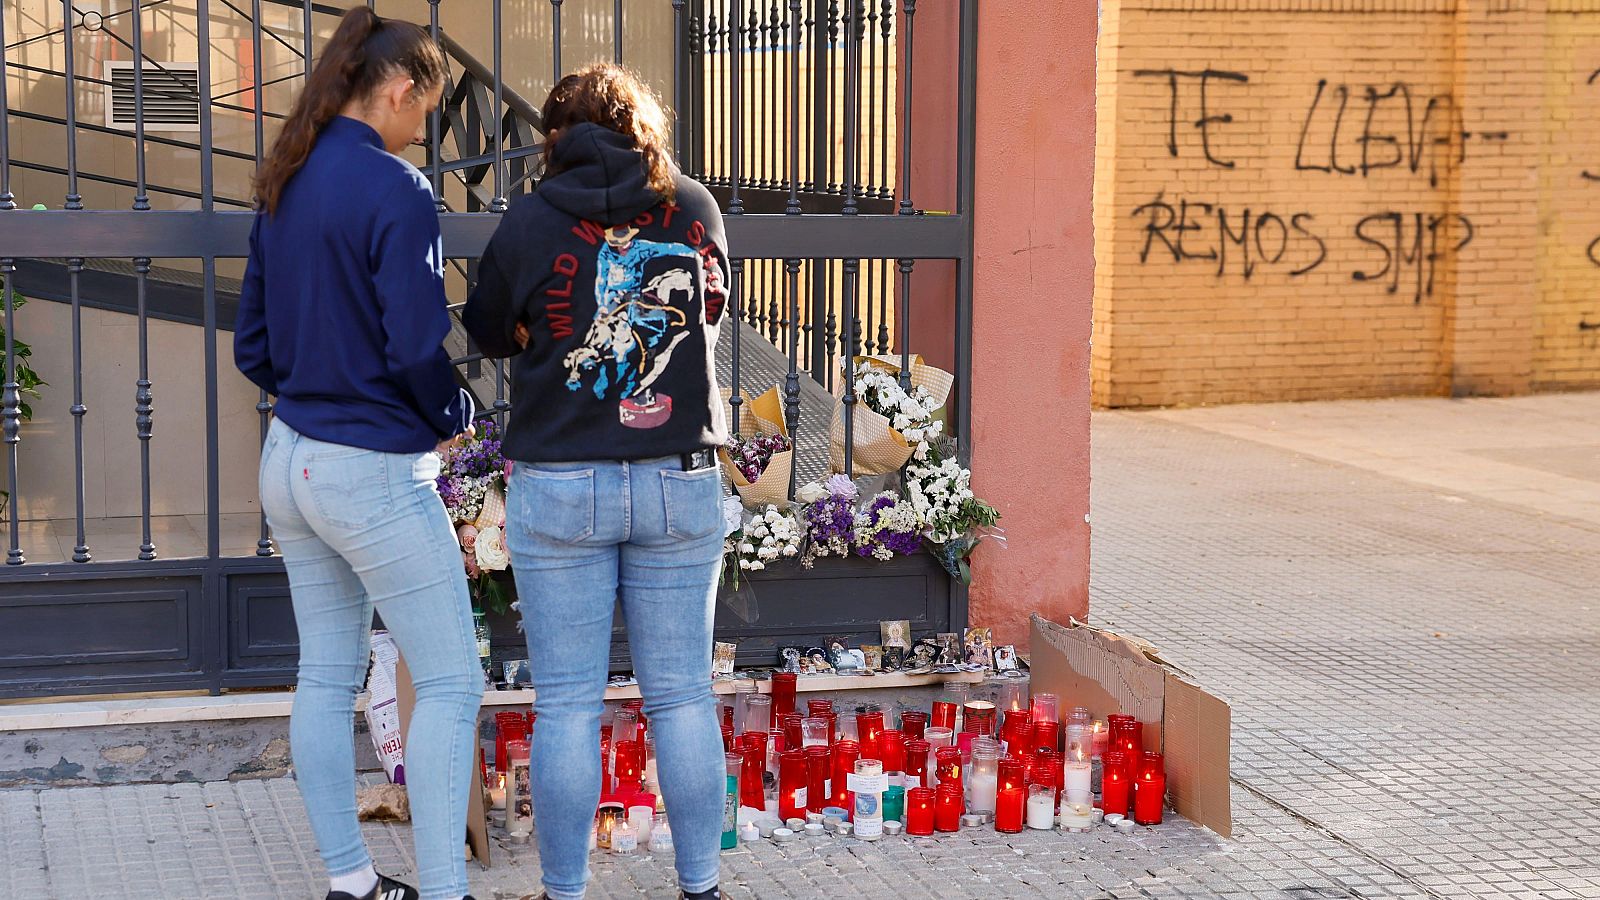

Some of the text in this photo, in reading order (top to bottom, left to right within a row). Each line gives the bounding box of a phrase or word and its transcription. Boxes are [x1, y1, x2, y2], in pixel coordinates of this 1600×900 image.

[1133, 69, 1248, 168] TE
[545, 253, 579, 340] WILD
[572, 204, 681, 246] WST
[1132, 190, 1326, 281] REMOS
[382, 738, 402, 755] TERA
